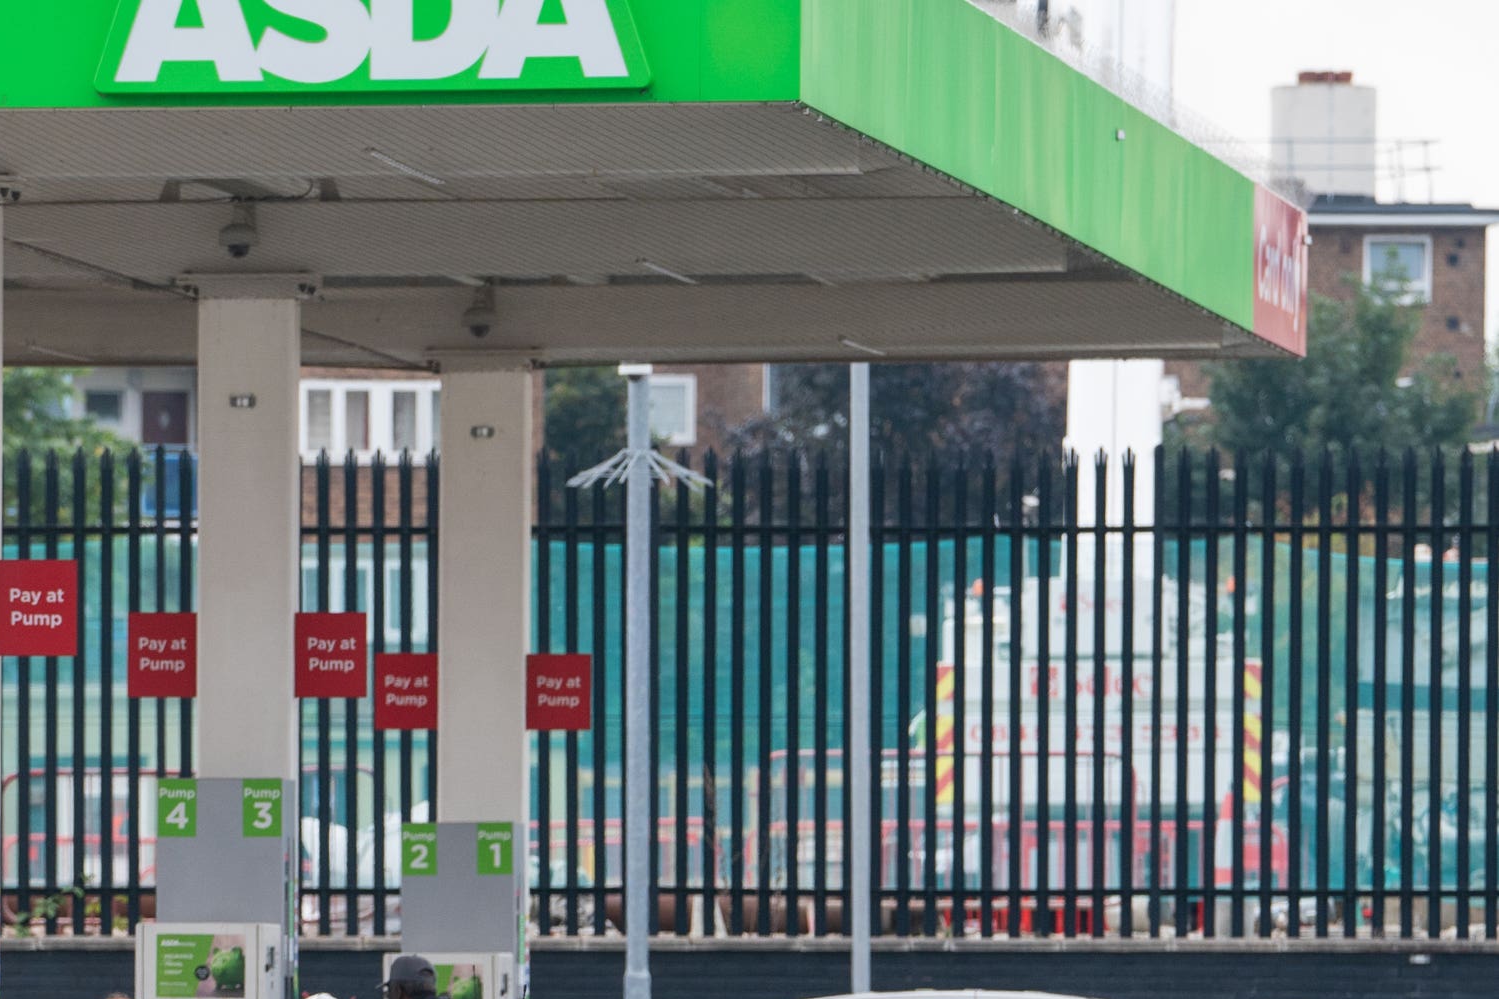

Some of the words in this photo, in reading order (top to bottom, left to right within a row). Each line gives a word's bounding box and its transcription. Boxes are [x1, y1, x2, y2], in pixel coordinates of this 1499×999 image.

[113, 0, 630, 84] ASDA
[9, 588, 42, 604] Pay
[45, 589, 65, 602] at
[10, 611, 63, 628] Pump
[138, 637, 165, 652] Pay
[170, 638, 187, 650] at
[307, 637, 335, 652] Pay
[339, 638, 357, 650] at
[139, 657, 186, 672] Pump
[308, 658, 355, 672] Pump
[384, 675, 409, 689] Pay
[413, 676, 429, 687] at
[536, 676, 561, 690] Pay
[565, 677, 581, 688] at
[385, 693, 428, 707] Pump
[537, 694, 580, 708] Pump
[159, 787, 196, 800] Pump
[244, 787, 281, 800] Pump
[165, 801, 189, 830] 4
[252, 801, 273, 829] 3
[403, 831, 436, 843] Pump
[478, 830, 511, 842] Pump
[409, 843, 429, 869] 2
[489, 842, 501, 869] 1
